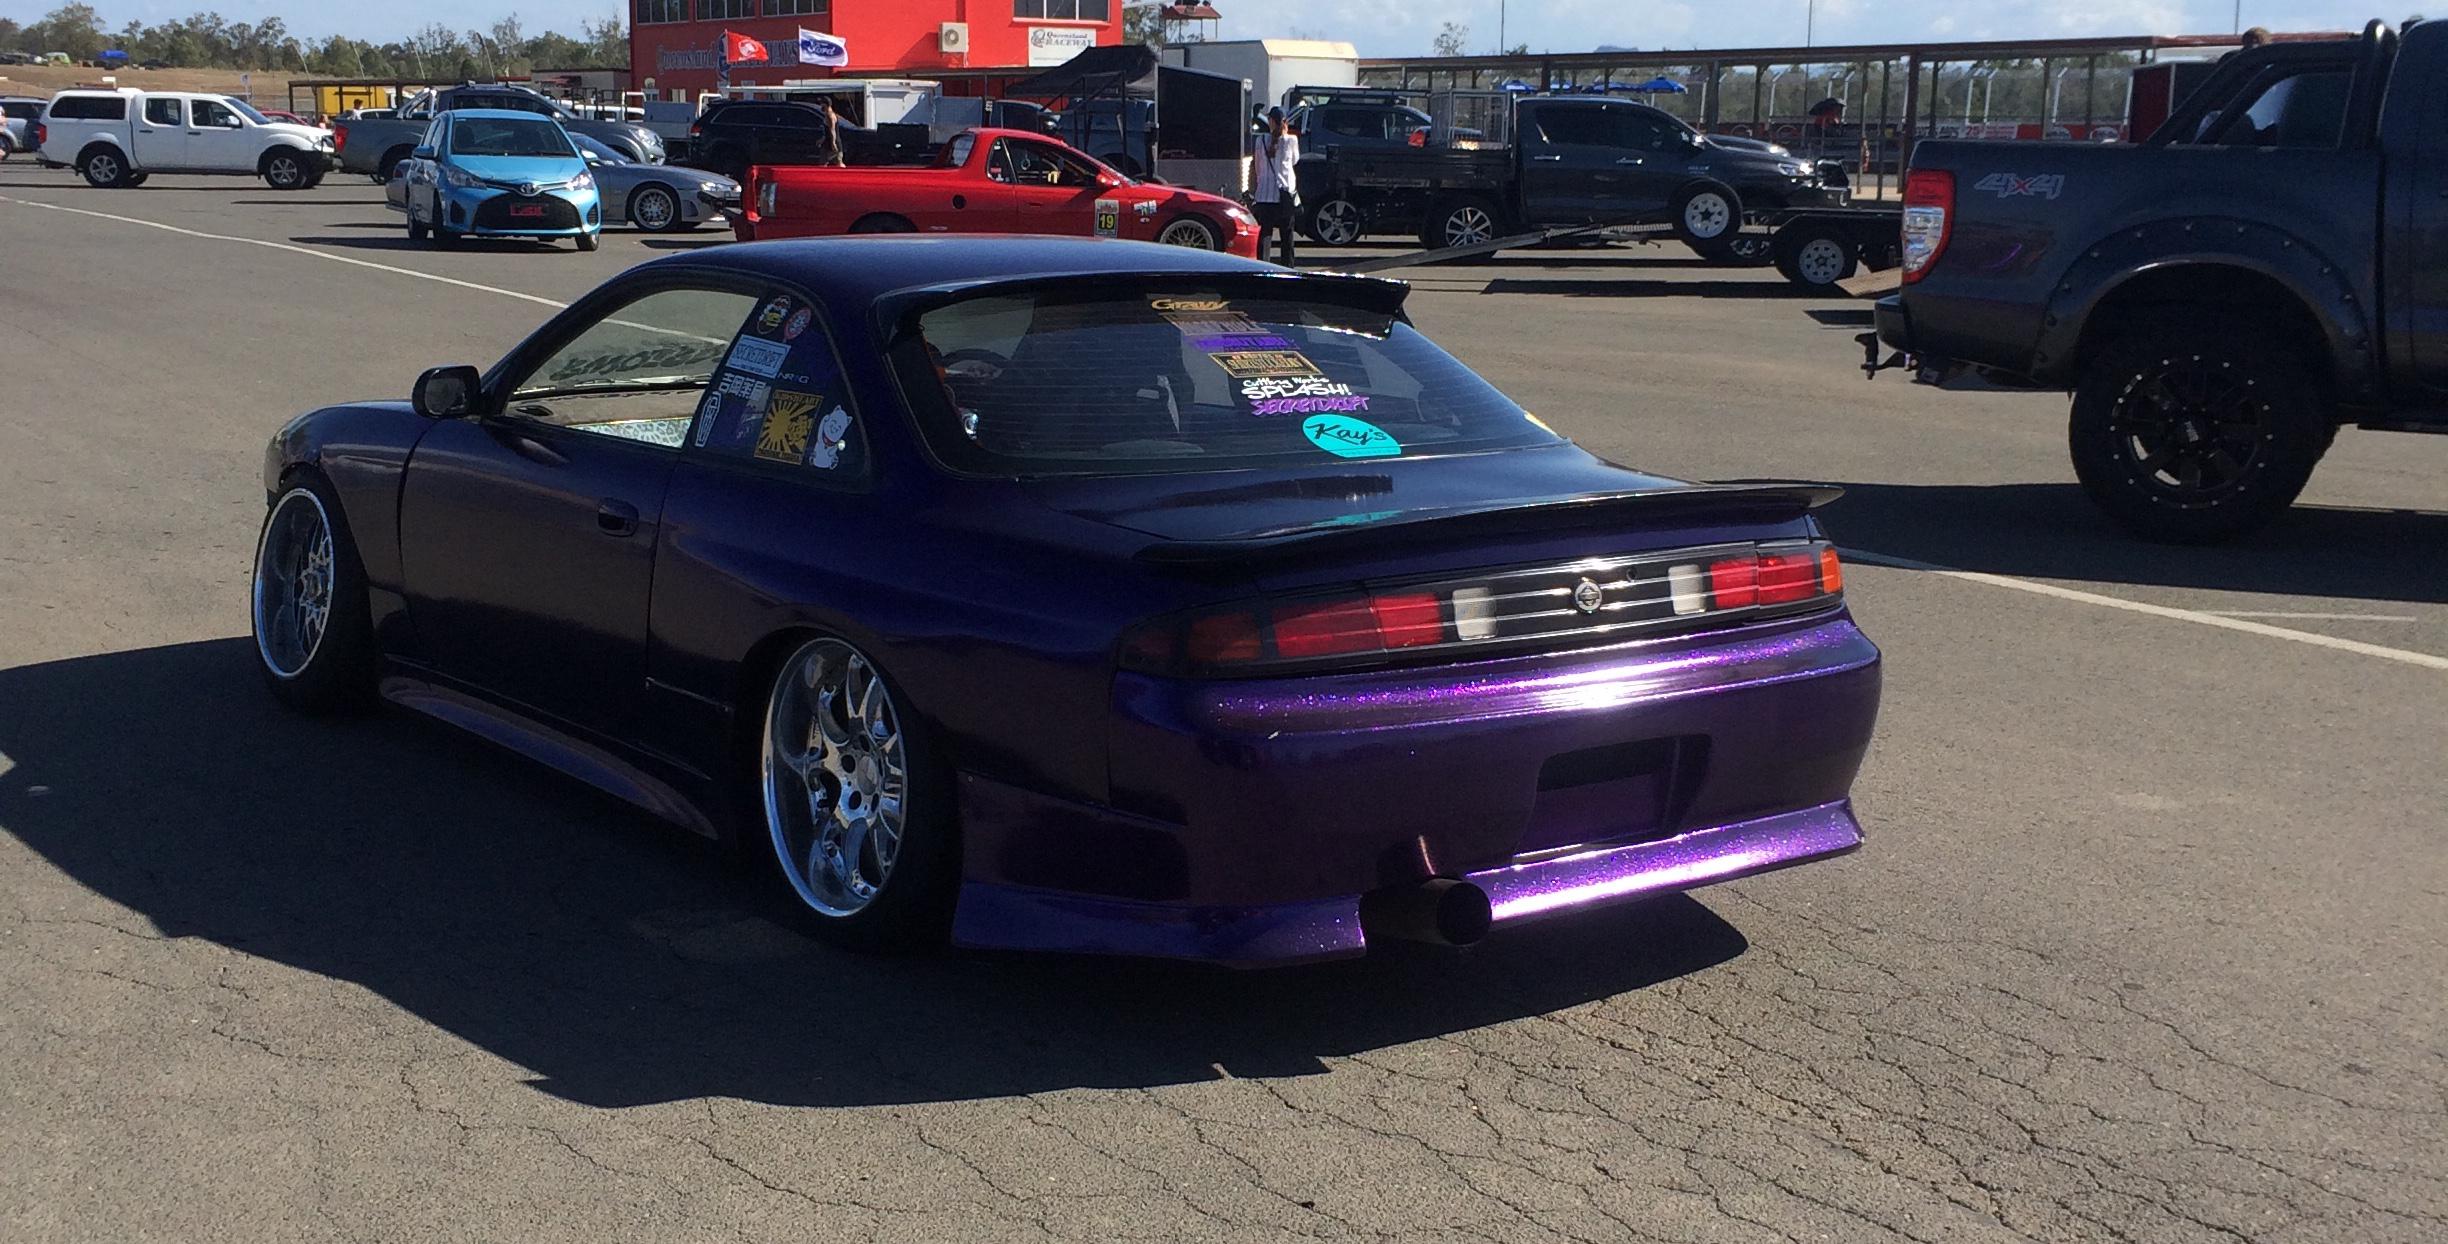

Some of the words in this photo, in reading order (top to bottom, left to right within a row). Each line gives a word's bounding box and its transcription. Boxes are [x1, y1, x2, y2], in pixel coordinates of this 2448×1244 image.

[805, 44, 837, 57] Ford
[1099, 214, 1115, 229] 19
[1241, 383, 1354, 400] SPLASH!
[1305, 421, 1389, 446] Kay's
